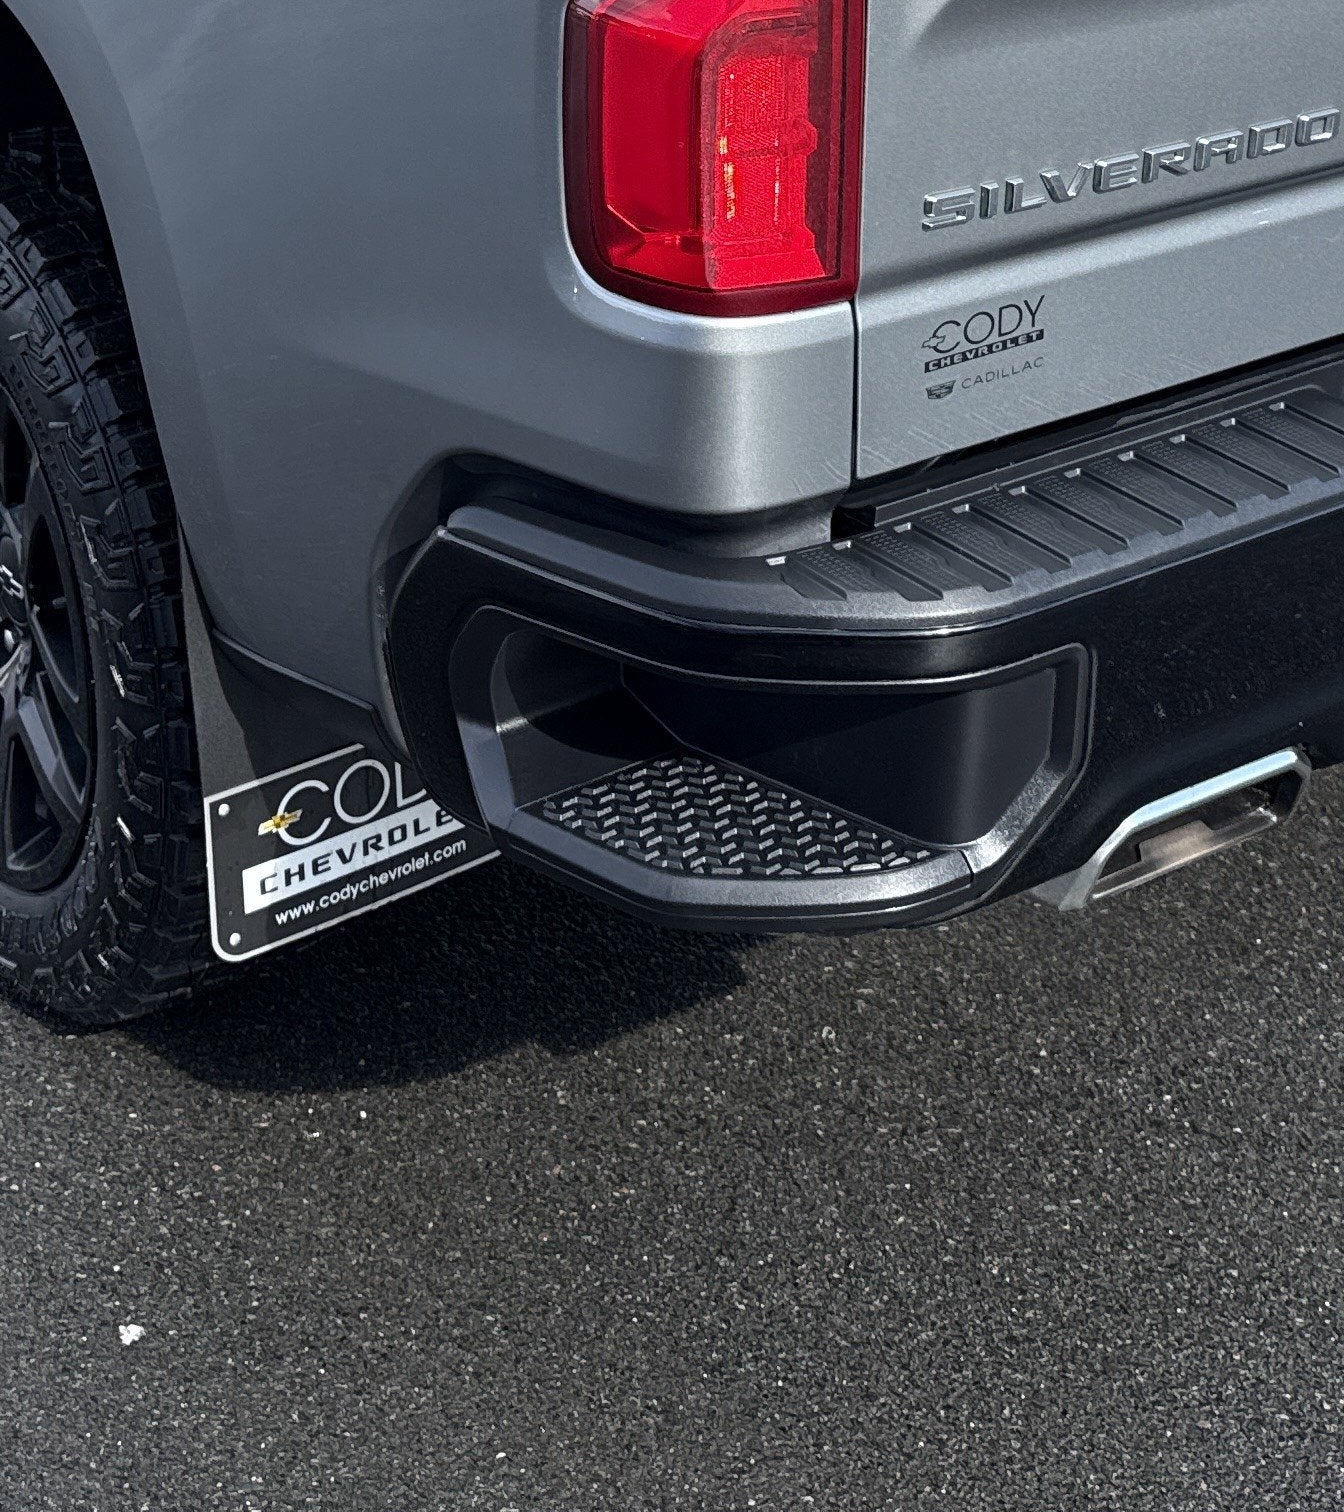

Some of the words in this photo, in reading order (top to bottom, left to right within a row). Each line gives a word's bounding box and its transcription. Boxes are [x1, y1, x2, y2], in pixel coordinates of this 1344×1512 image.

[921, 107, 1341, 232] SILVERADO
[922, 294, 1046, 355] CODY
[926, 330, 1043, 372] CHEVROLET
[961, 356, 1044, 390] CADILLAC
[275, 839, 467, 926] www.codychevrolet.com
